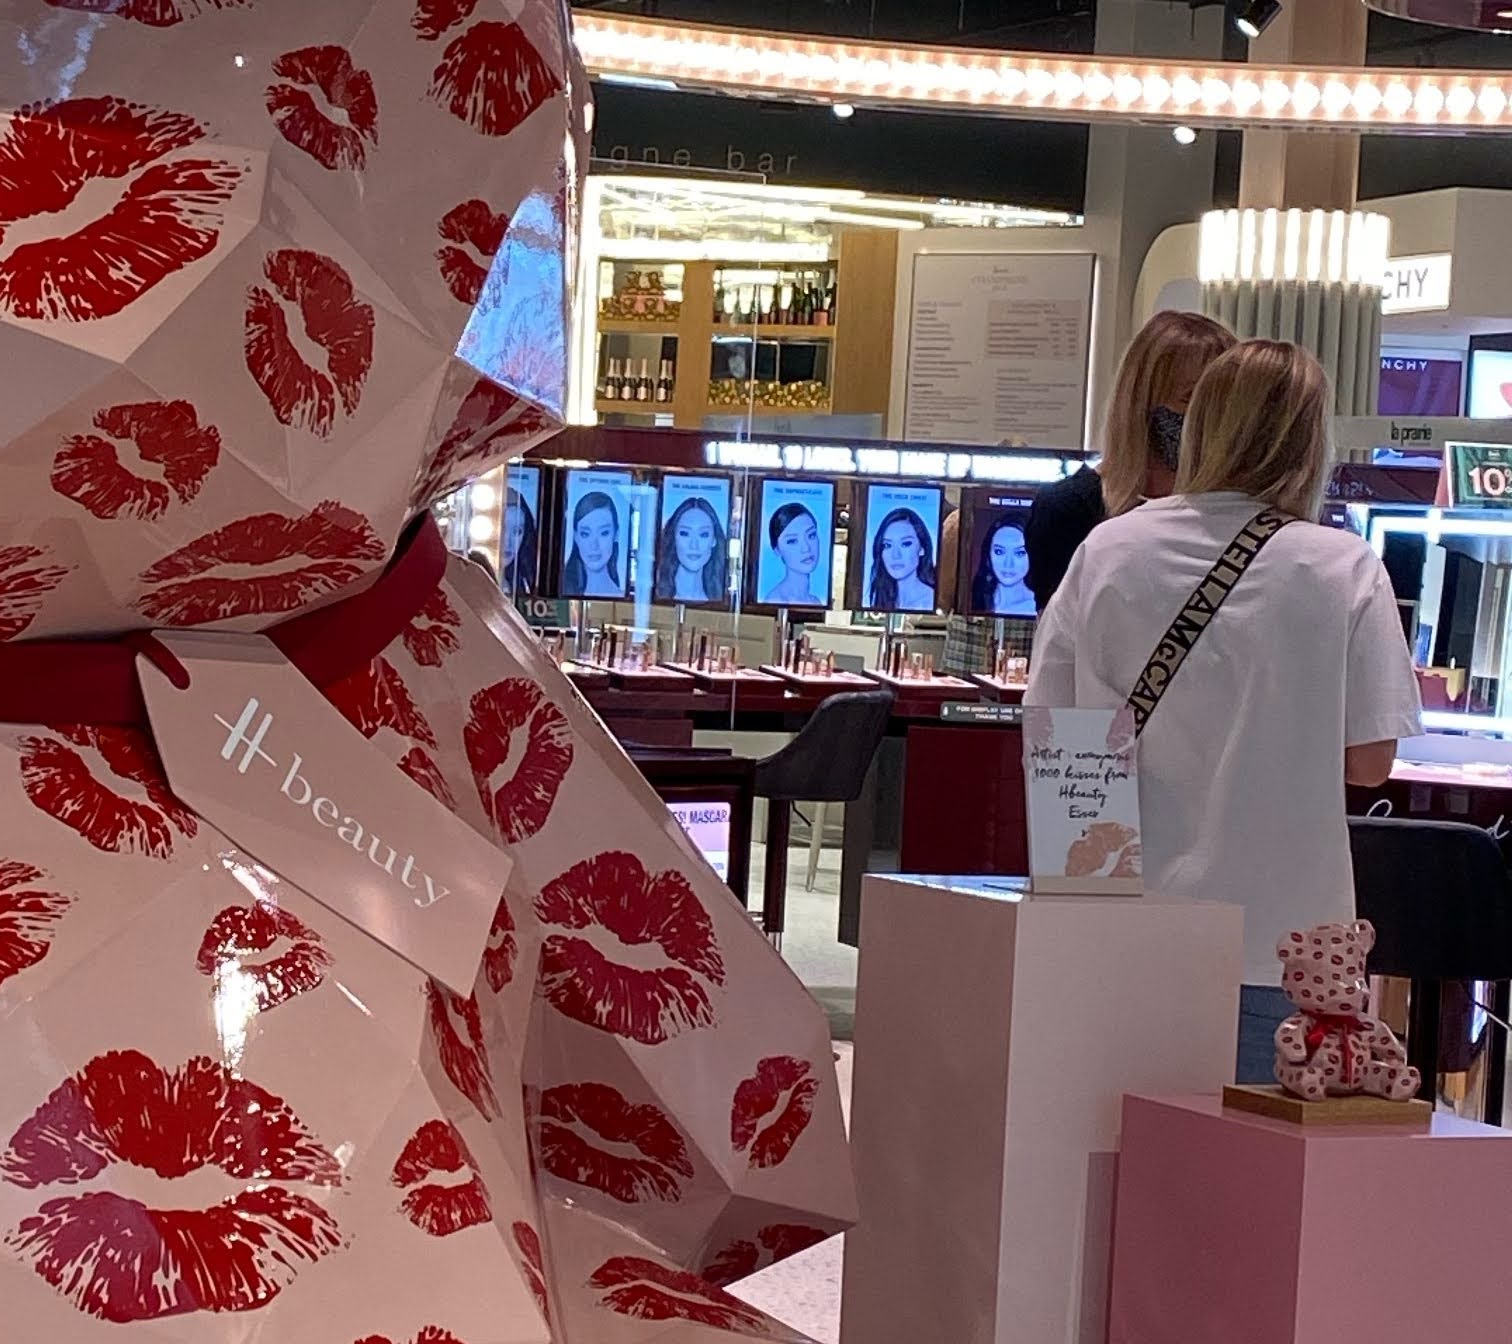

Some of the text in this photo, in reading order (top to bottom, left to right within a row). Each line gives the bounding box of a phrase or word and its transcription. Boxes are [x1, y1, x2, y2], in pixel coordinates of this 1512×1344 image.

[589, 144, 798, 174] gne bar
[280, 752, 451, 908] beauty
